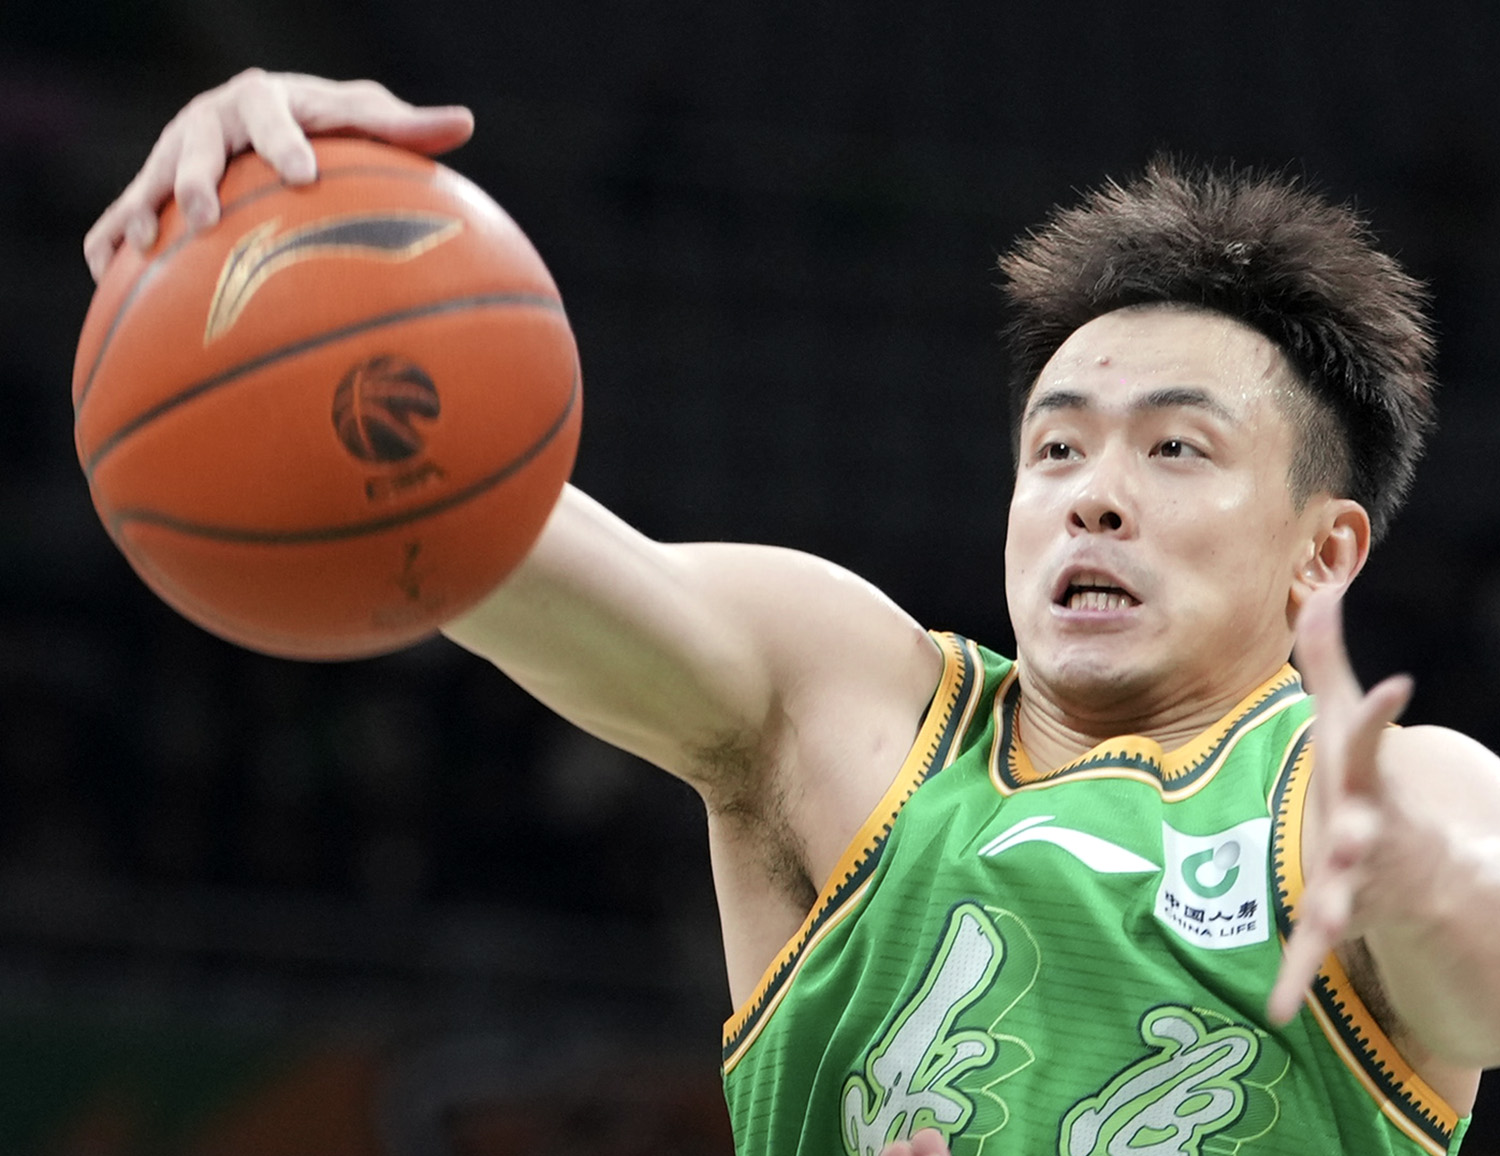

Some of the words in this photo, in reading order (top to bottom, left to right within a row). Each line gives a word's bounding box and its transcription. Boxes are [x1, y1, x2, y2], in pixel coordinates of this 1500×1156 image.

[1165, 890, 1259, 923] 中国人寿
[1219, 920, 1257, 937] LIFE
